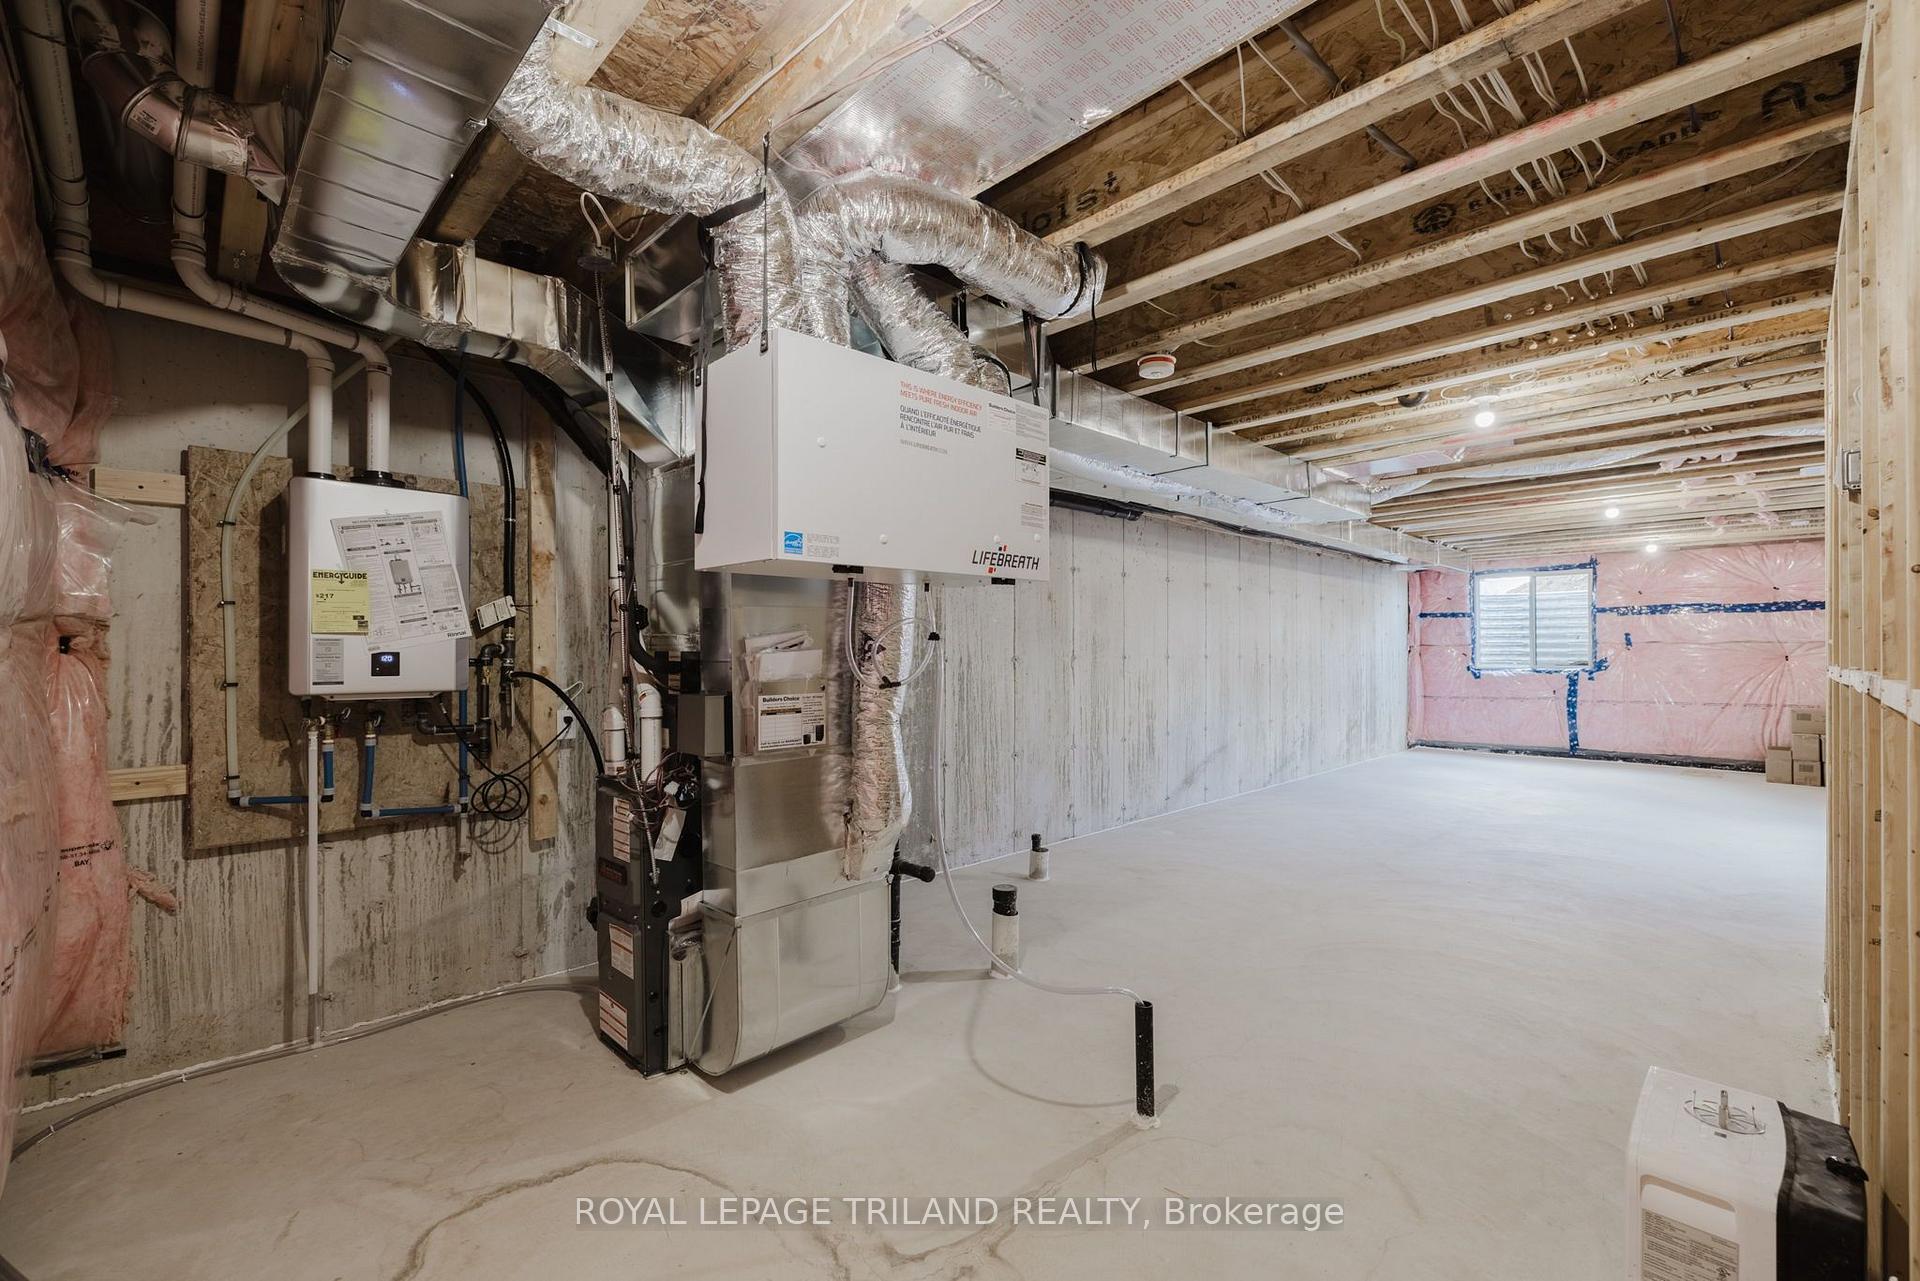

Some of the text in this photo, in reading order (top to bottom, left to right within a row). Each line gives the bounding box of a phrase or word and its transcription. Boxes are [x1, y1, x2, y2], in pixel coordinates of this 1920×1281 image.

[1250, 295, 1289, 310] MADE
[1299, 283, 1318, 295] IN
[1327, 259, 1392, 286] CANADA
[900, 405, 920, 417] QUAND
[900, 413, 931, 427] RENCONTRE
[972, 550, 1040, 571] LIFEBREATH
